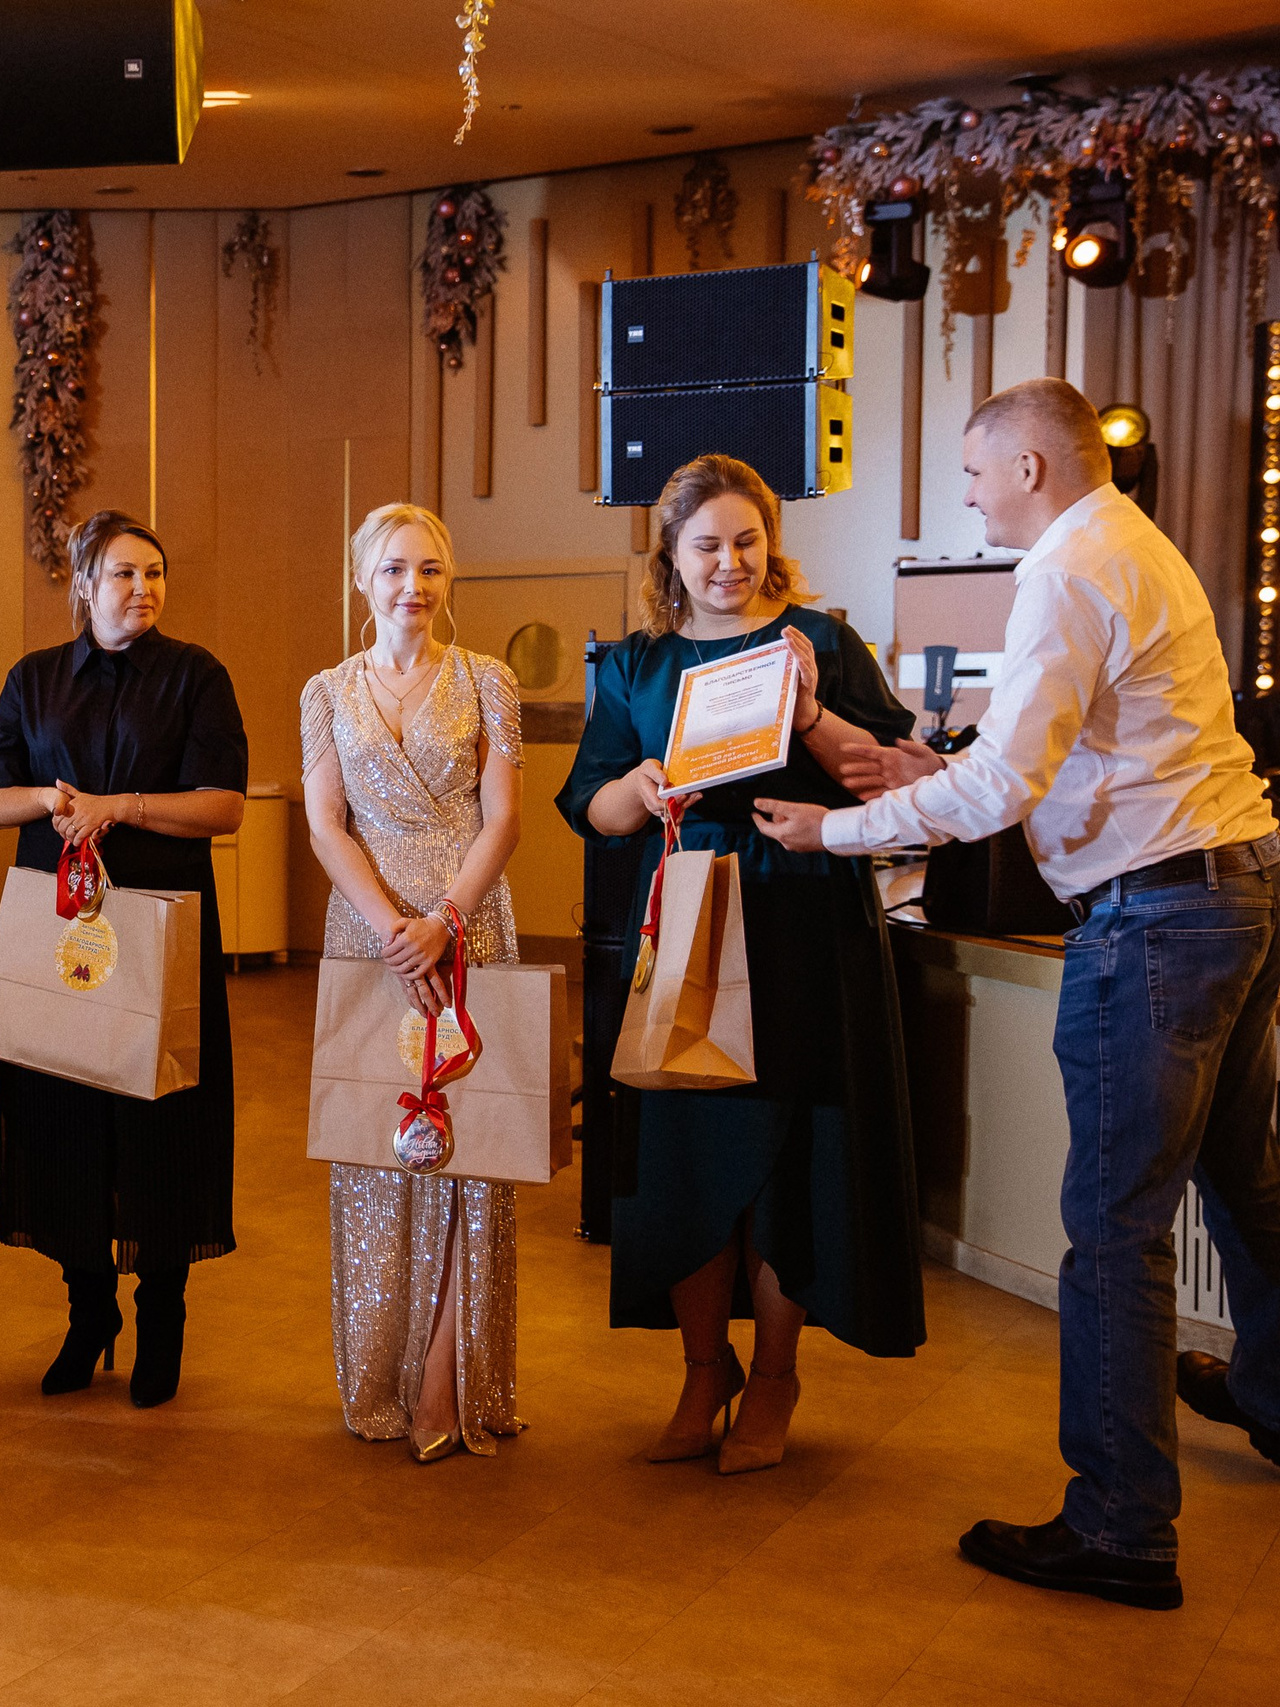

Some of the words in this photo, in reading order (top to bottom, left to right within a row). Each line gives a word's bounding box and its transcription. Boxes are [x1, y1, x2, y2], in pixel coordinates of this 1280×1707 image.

[704, 660, 776, 686] БЛАГОДАРСТВЕННОЕ
[722, 674, 753, 687] ПИСЬМО
[689, 758, 727, 773] успешной
[727, 749, 759, 762] работы!
[723, 751, 736, 759] лет
[69, 936, 111, 952] БЛАГОДАРНОСТЬ
